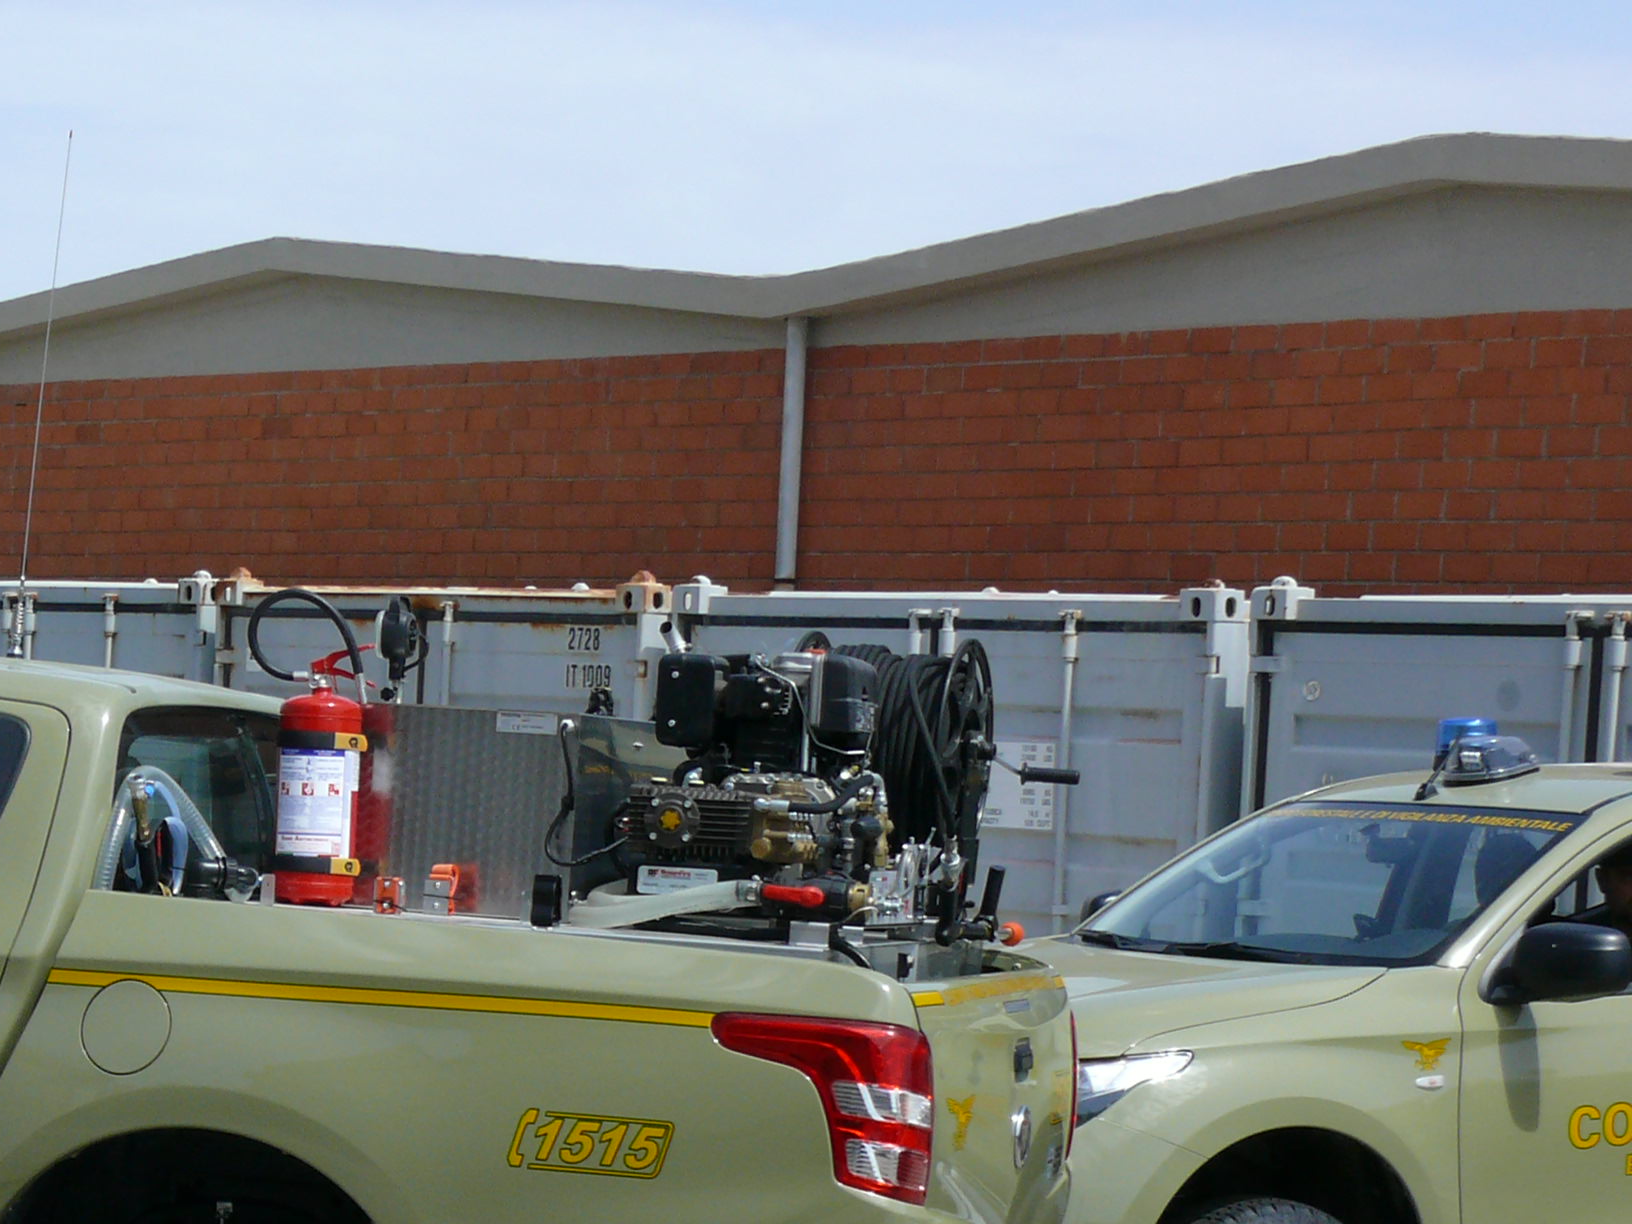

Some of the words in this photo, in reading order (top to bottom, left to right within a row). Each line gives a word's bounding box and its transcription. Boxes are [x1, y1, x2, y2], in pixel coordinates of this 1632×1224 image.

[568, 627, 601, 651] 2728
[566, 664, 578, 688] IT
[582, 664, 612, 688] 1009
[1468, 813, 1574, 832] AMBIENTALE
[534, 1117, 667, 1170] 1515
